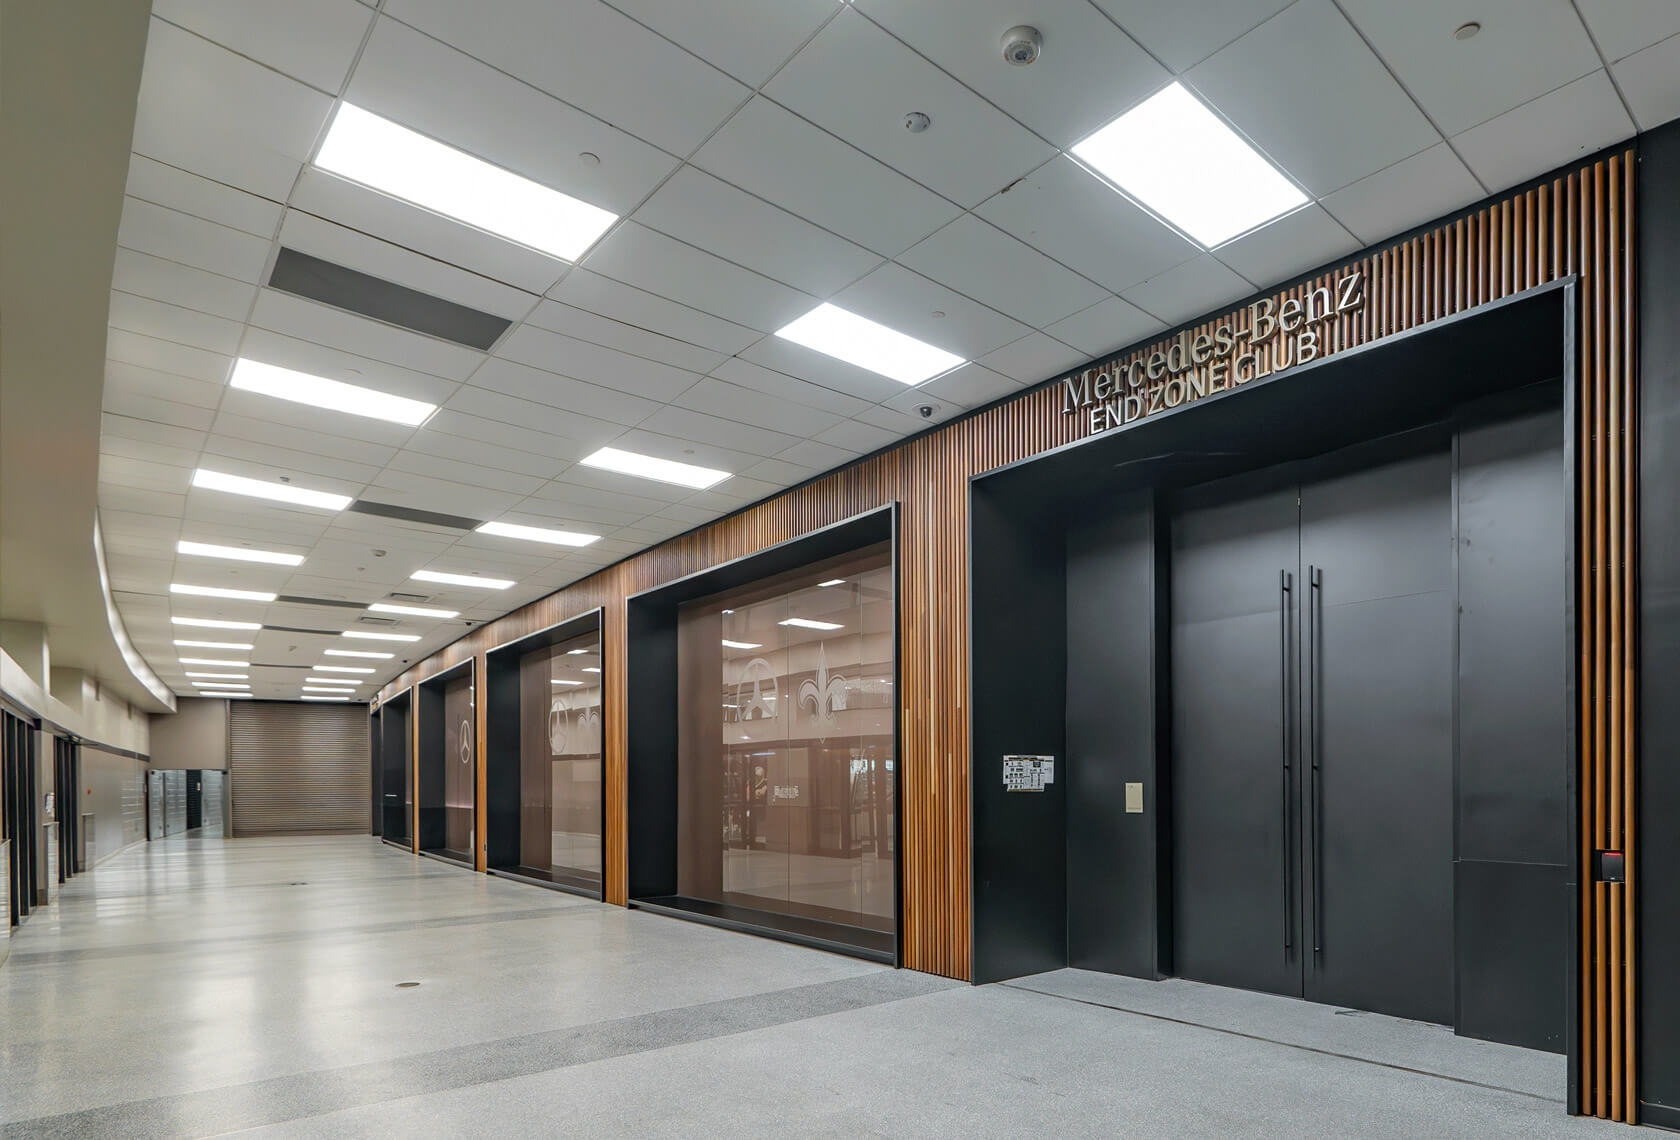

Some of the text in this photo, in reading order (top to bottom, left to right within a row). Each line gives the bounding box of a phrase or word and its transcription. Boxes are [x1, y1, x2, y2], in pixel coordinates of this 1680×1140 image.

[1062, 271, 1363, 416] Mercedes-Benz
[1090, 331, 1319, 435] END ZONE CLUB
